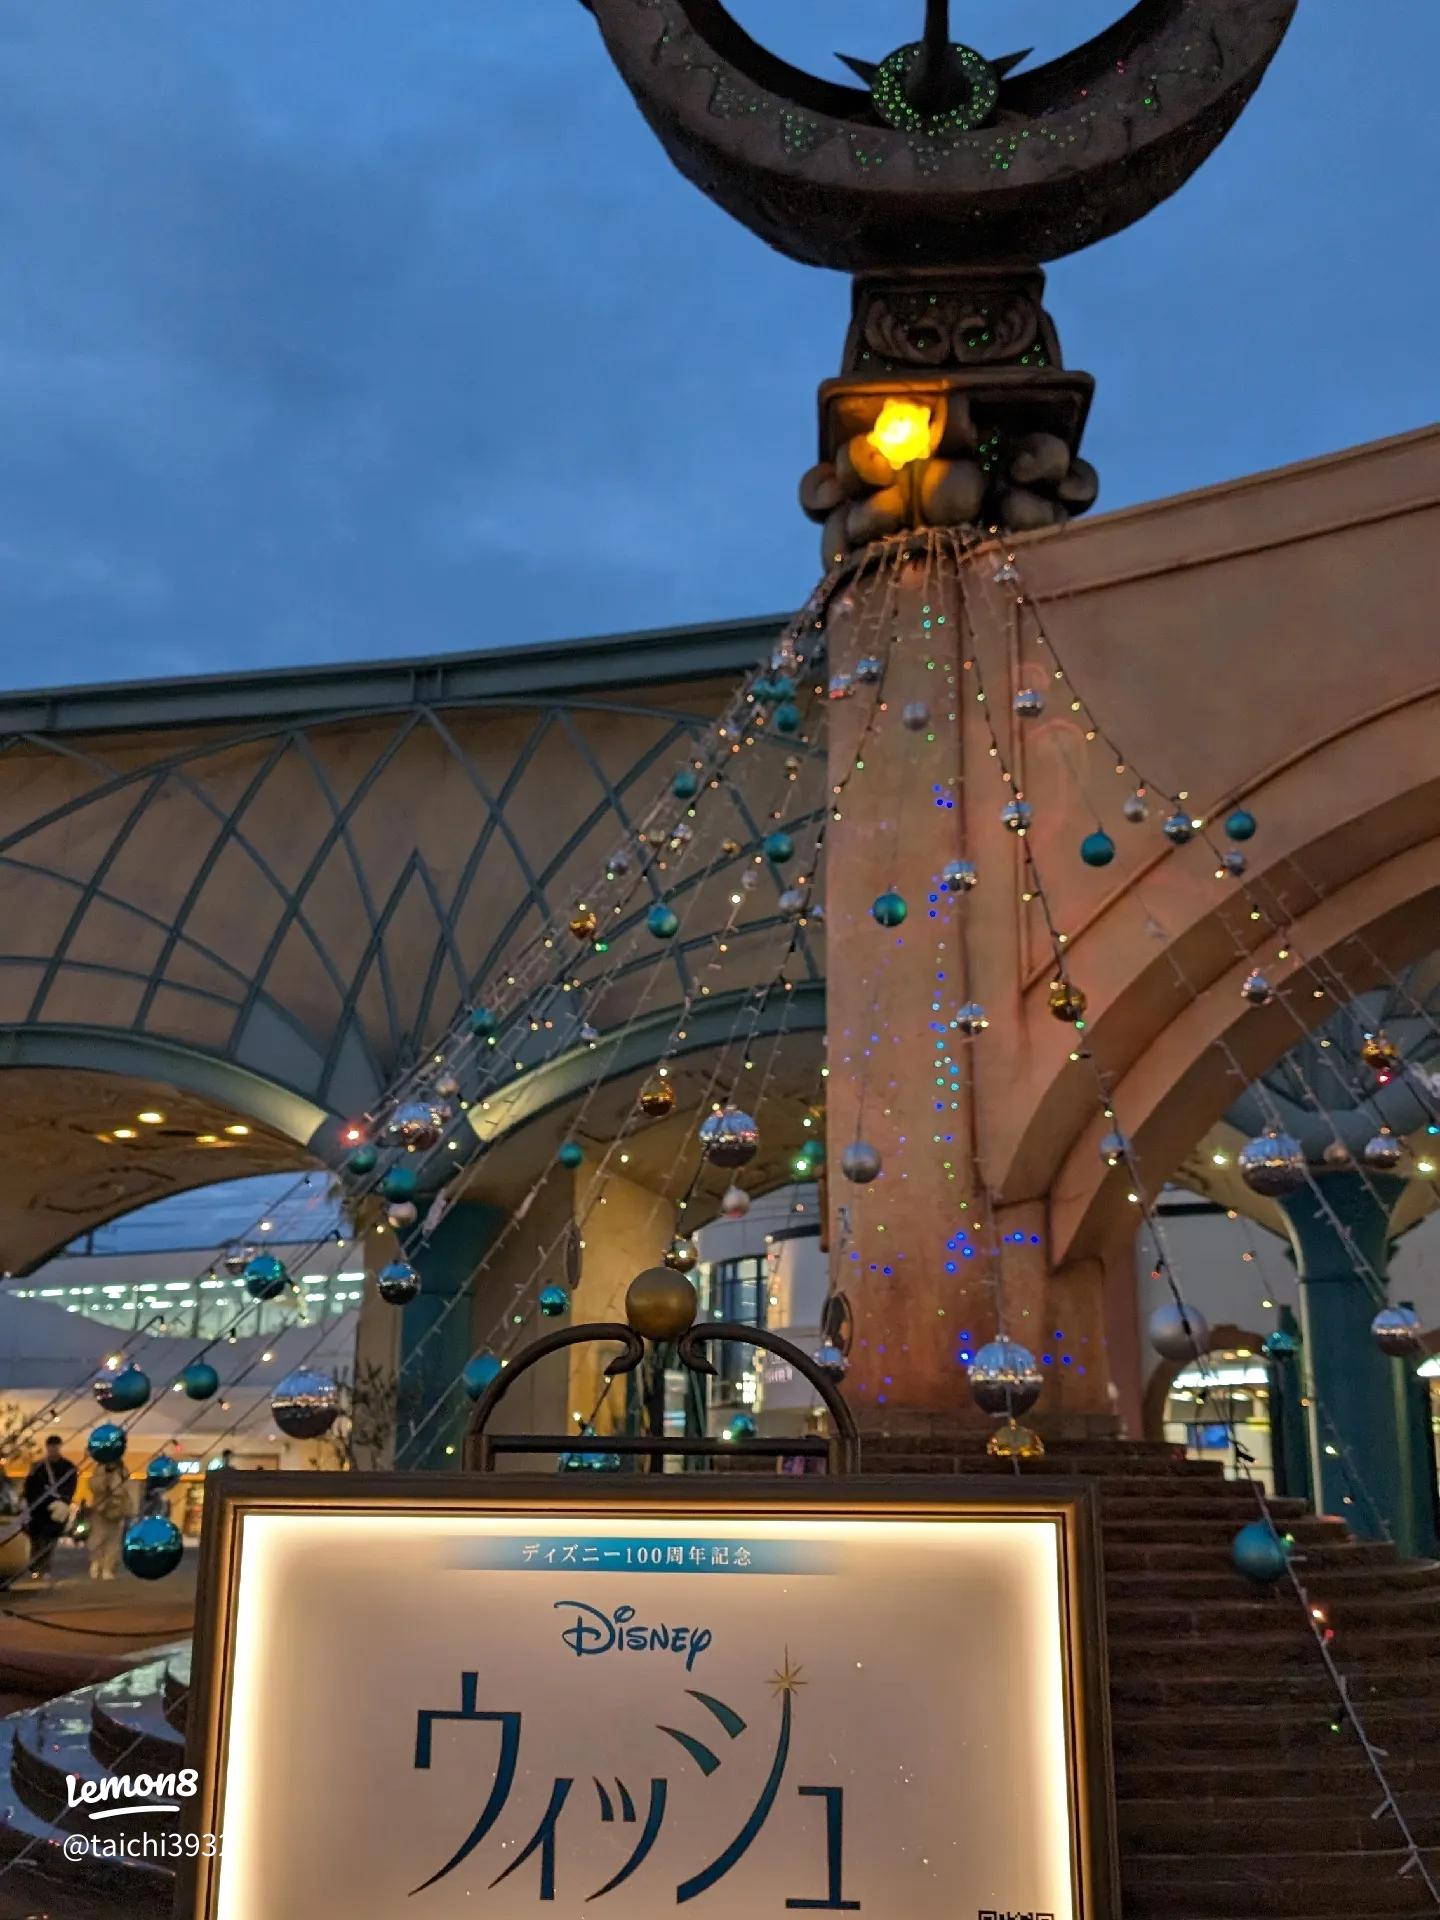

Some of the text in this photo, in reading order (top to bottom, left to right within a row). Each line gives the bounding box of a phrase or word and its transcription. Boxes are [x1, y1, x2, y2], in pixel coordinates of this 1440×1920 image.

[522, 1543, 752, 1567] ディズニー100周年記念
[407, 1671, 861, 1910] ウィッシュ
